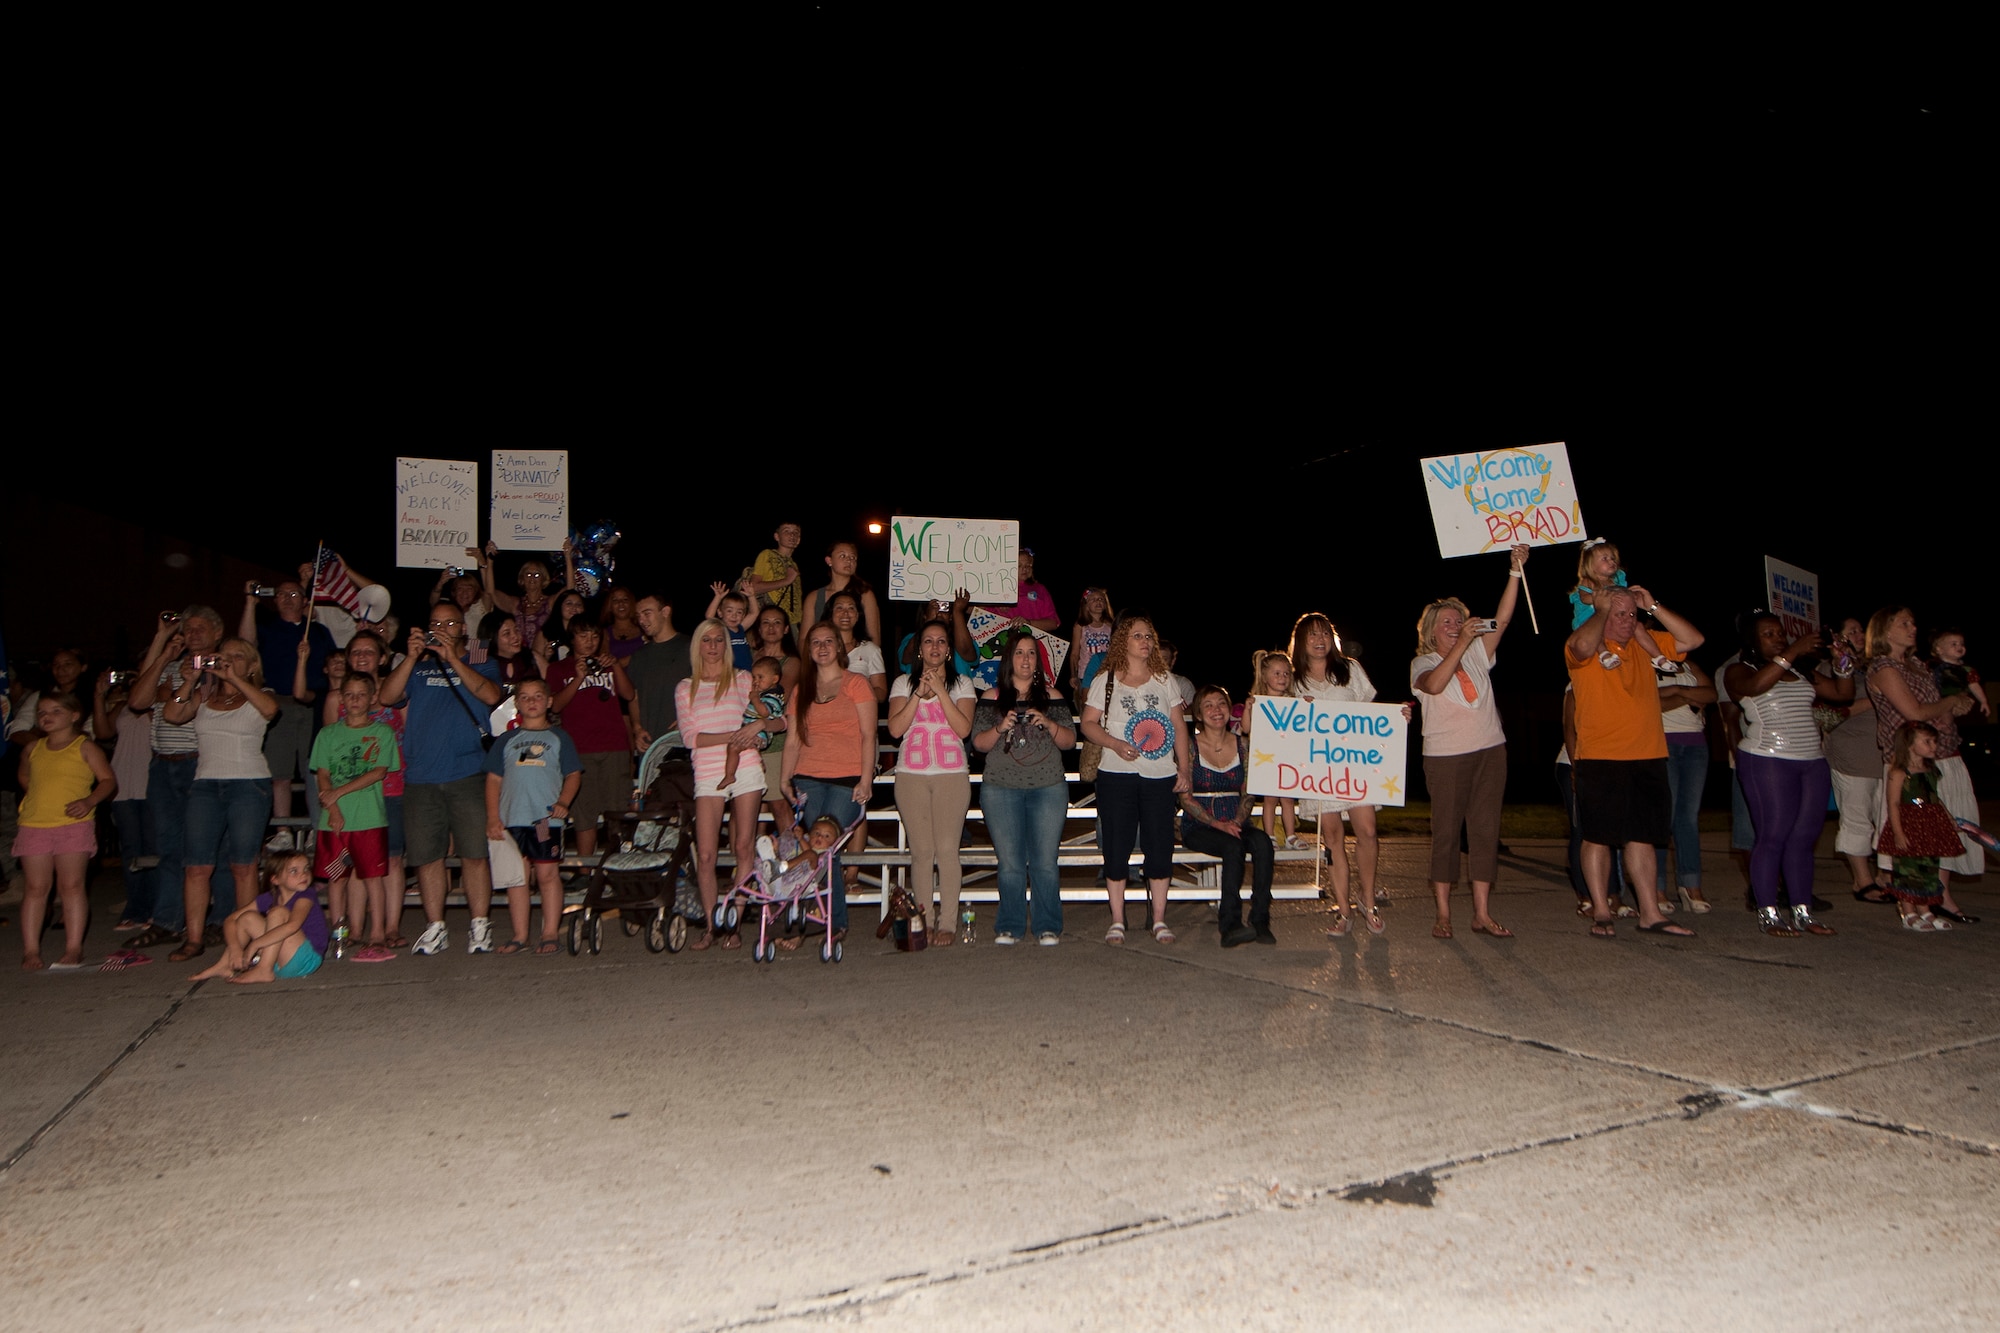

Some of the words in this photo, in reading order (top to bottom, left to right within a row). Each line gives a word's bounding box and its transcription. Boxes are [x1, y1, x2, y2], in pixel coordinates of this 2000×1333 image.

[529, 457, 547, 466] Dan
[1428, 453, 1552, 489] Welcome
[397, 471, 474, 500] WELCOME
[503, 470, 557, 485] BRAVATO
[1468, 486, 1546, 515] Home
[427, 515, 447, 526] Dan
[502, 509, 559, 522] Welcome
[514, 525, 540, 534] Back
[1485, 500, 1580, 544] BRAD!
[892, 521, 1017, 564] WELCOME
[891, 560, 905, 598] HOME
[907, 563, 1018, 596] SOLDIERS
[1772, 572, 1813, 602] WELCOME
[1782, 594, 1806, 617] HOME
[1260, 700, 1393, 737] Welcome
[905, 726, 964, 770] 86
[1309, 738, 1384, 764] Home
[1277, 763, 1368, 801] Daddy
